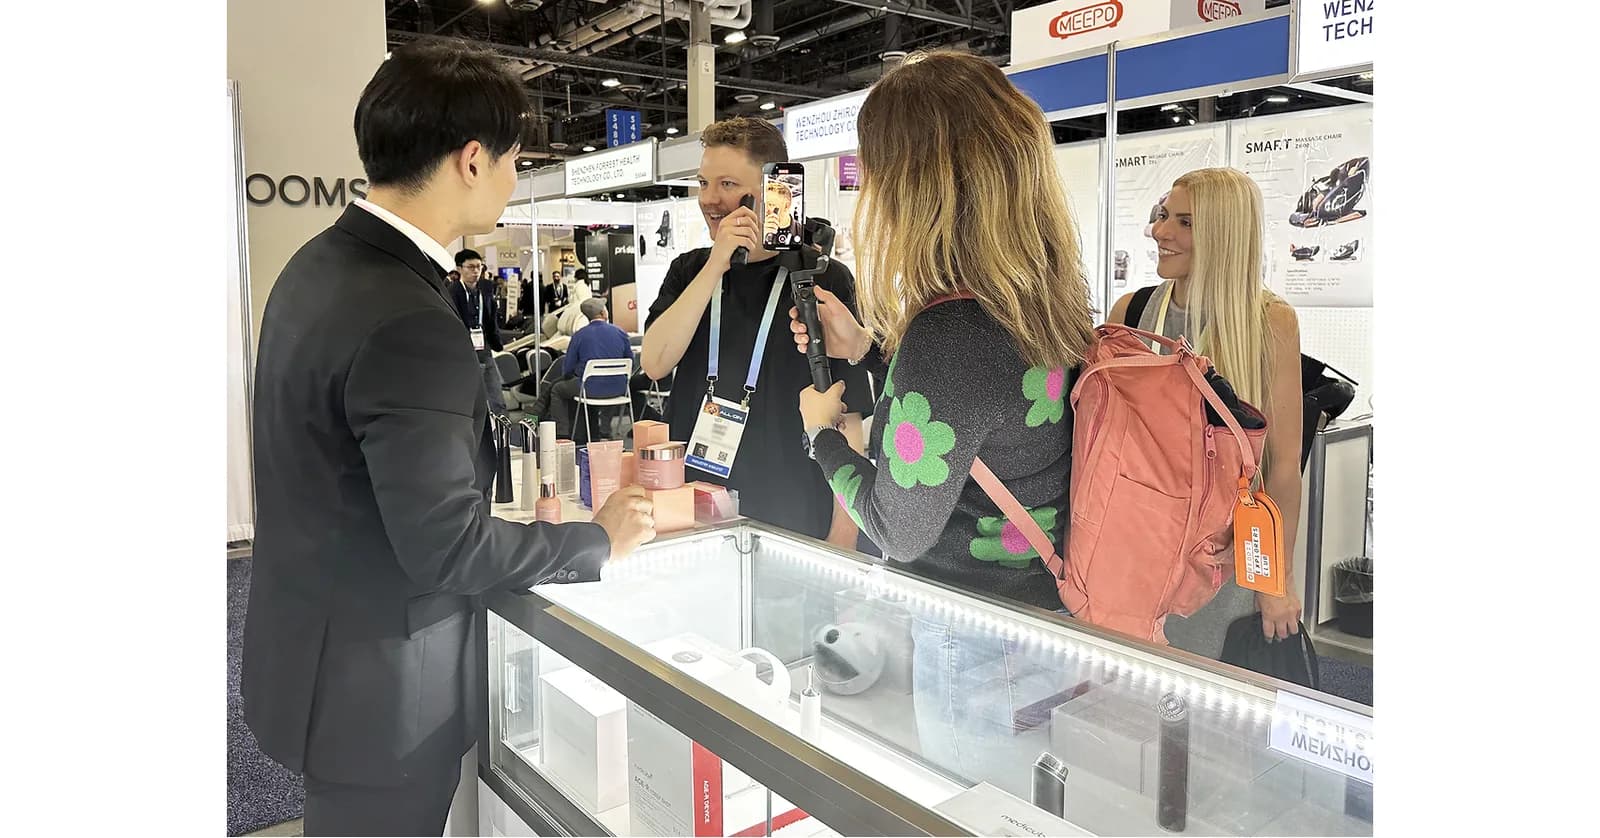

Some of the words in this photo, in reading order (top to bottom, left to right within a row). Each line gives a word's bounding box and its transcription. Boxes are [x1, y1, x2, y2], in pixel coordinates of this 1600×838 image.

[1059, 6, 1115, 33] MEEPO
[1322, 16, 1373, 41] TECH
[796, 110, 831, 128] WENZHOU
[832, 105, 859, 121] ZHIRO
[796, 121, 846, 142] TECHNOLOGY
